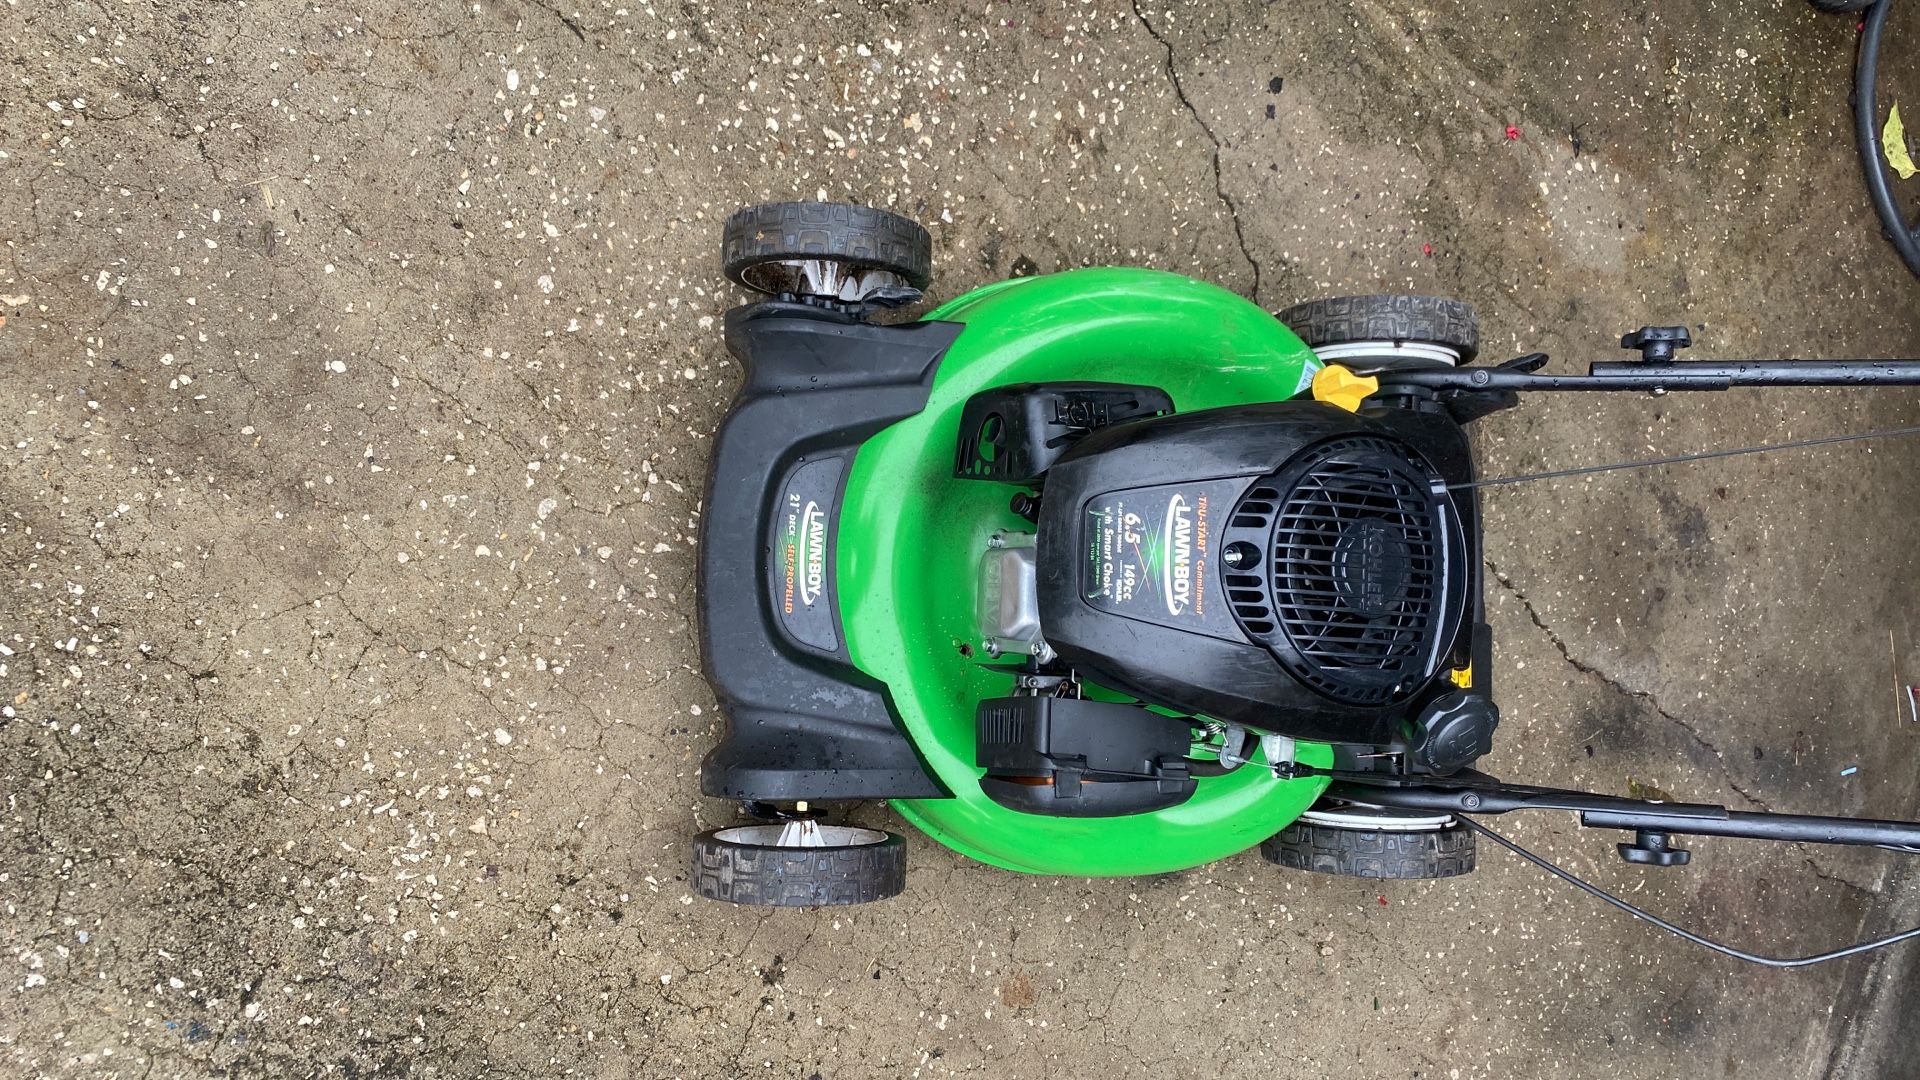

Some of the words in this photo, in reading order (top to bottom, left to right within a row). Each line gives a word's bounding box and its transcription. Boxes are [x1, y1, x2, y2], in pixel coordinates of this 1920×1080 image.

[788, 514, 796, 536] DECK
[1124, 512, 1141, 544] 6.5
[1104, 528, 1114, 560] Smart
[785, 545, 796, 614] SELF-PROPELLED
[1103, 563, 1113, 596] Choke
[1123, 563, 1135, 600] 149cc
